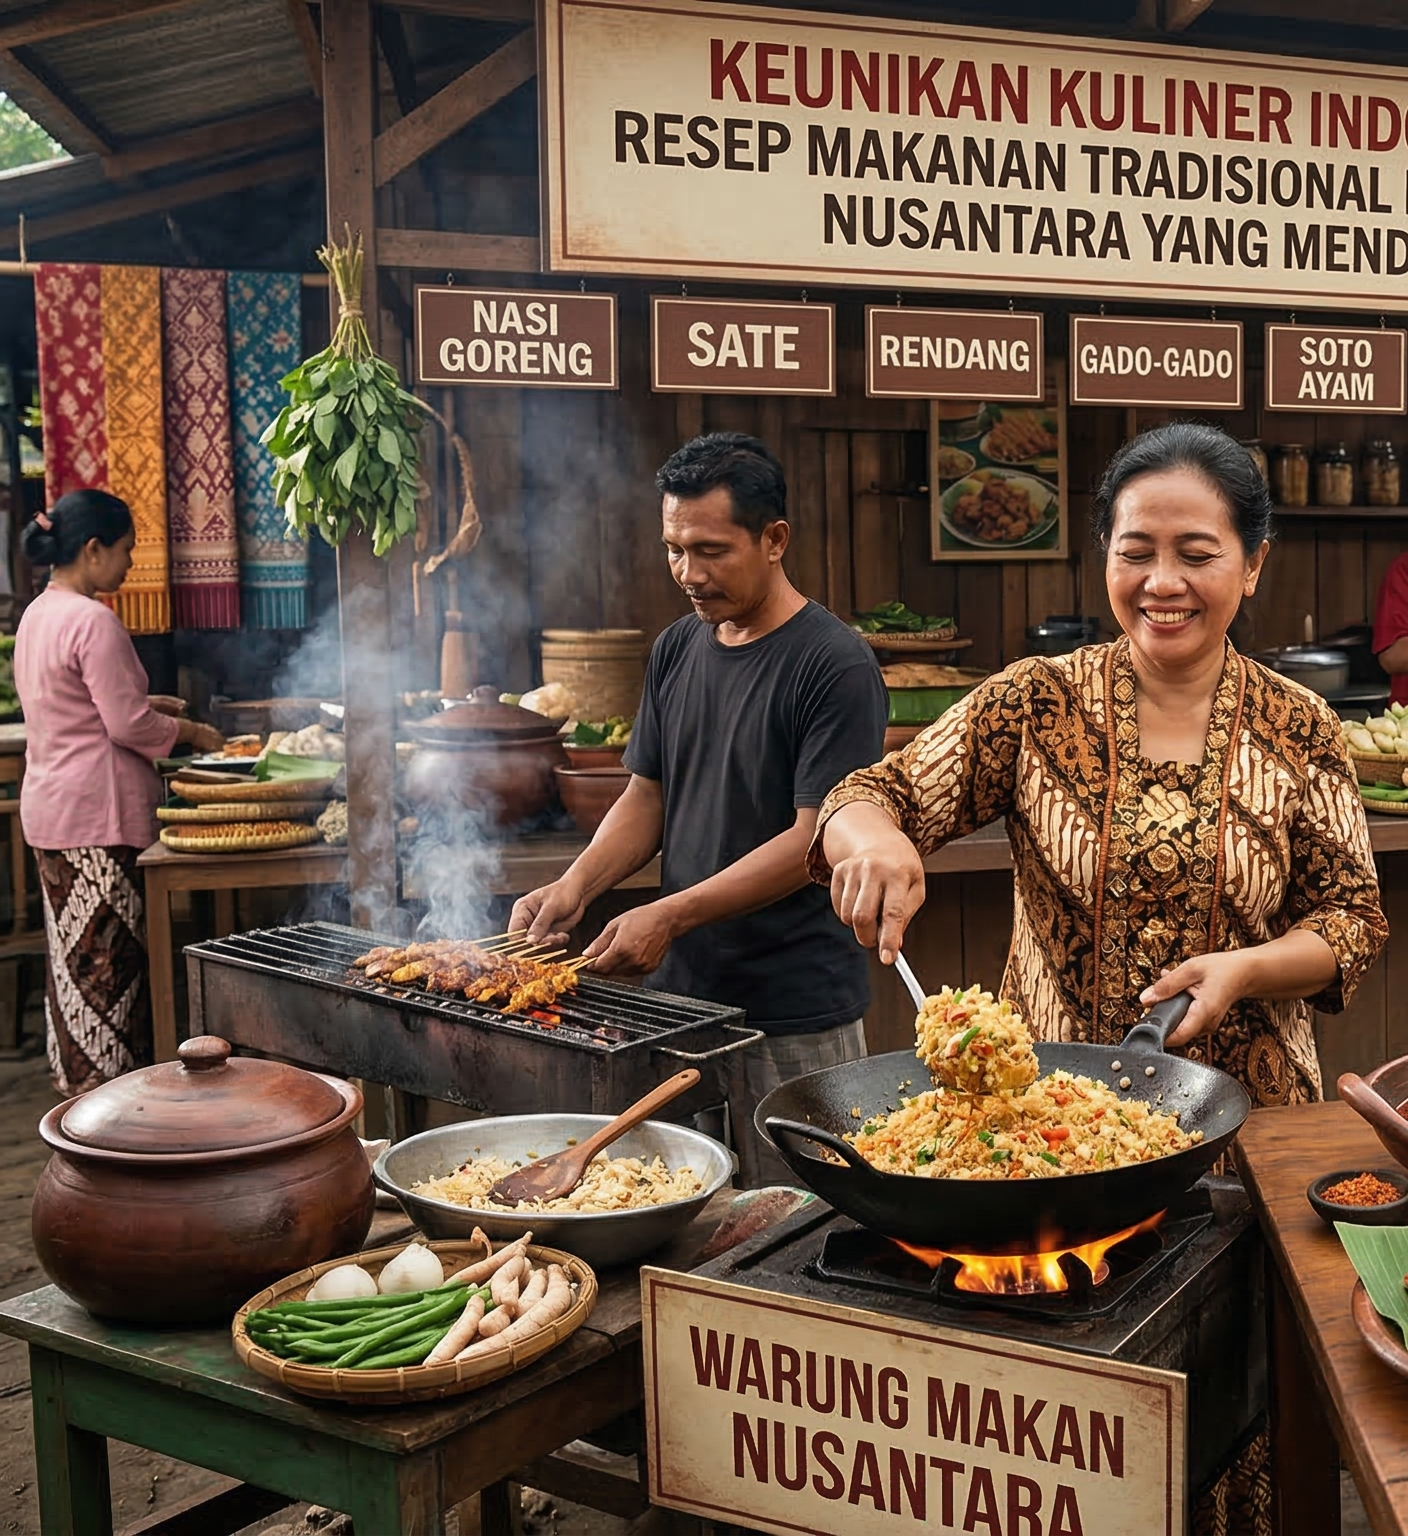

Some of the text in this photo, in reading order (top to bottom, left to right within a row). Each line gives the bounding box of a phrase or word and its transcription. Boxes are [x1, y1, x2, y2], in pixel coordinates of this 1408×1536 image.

[709, 38, 1029, 125] KEUNIKAN
[1051, 68, 1292, 144] KULINER
[615, 110, 792, 173] RESEP
[807, 125, 1066, 192] MAKANAN
[1080, 145, 1392, 214] TRADISIONAL
[823, 193, 1131, 260] NUSANTARA
[1142, 213, 1268, 268] YANG
[473, 300, 558, 336] NASI
[439, 338, 593, 377] GORENG
[687, 321, 800, 370] SATE
[880, 335, 1030, 373] RENDANG
[1080, 344, 1233, 379] GADO-GADO
[1300, 337, 1373, 368] SOTO
[1298, 371, 1374, 401] AYAM
[689, 1325, 1125, 1478] WARUNG MAKAN
[732, 1412, 1085, 1536] NUSANTARA
